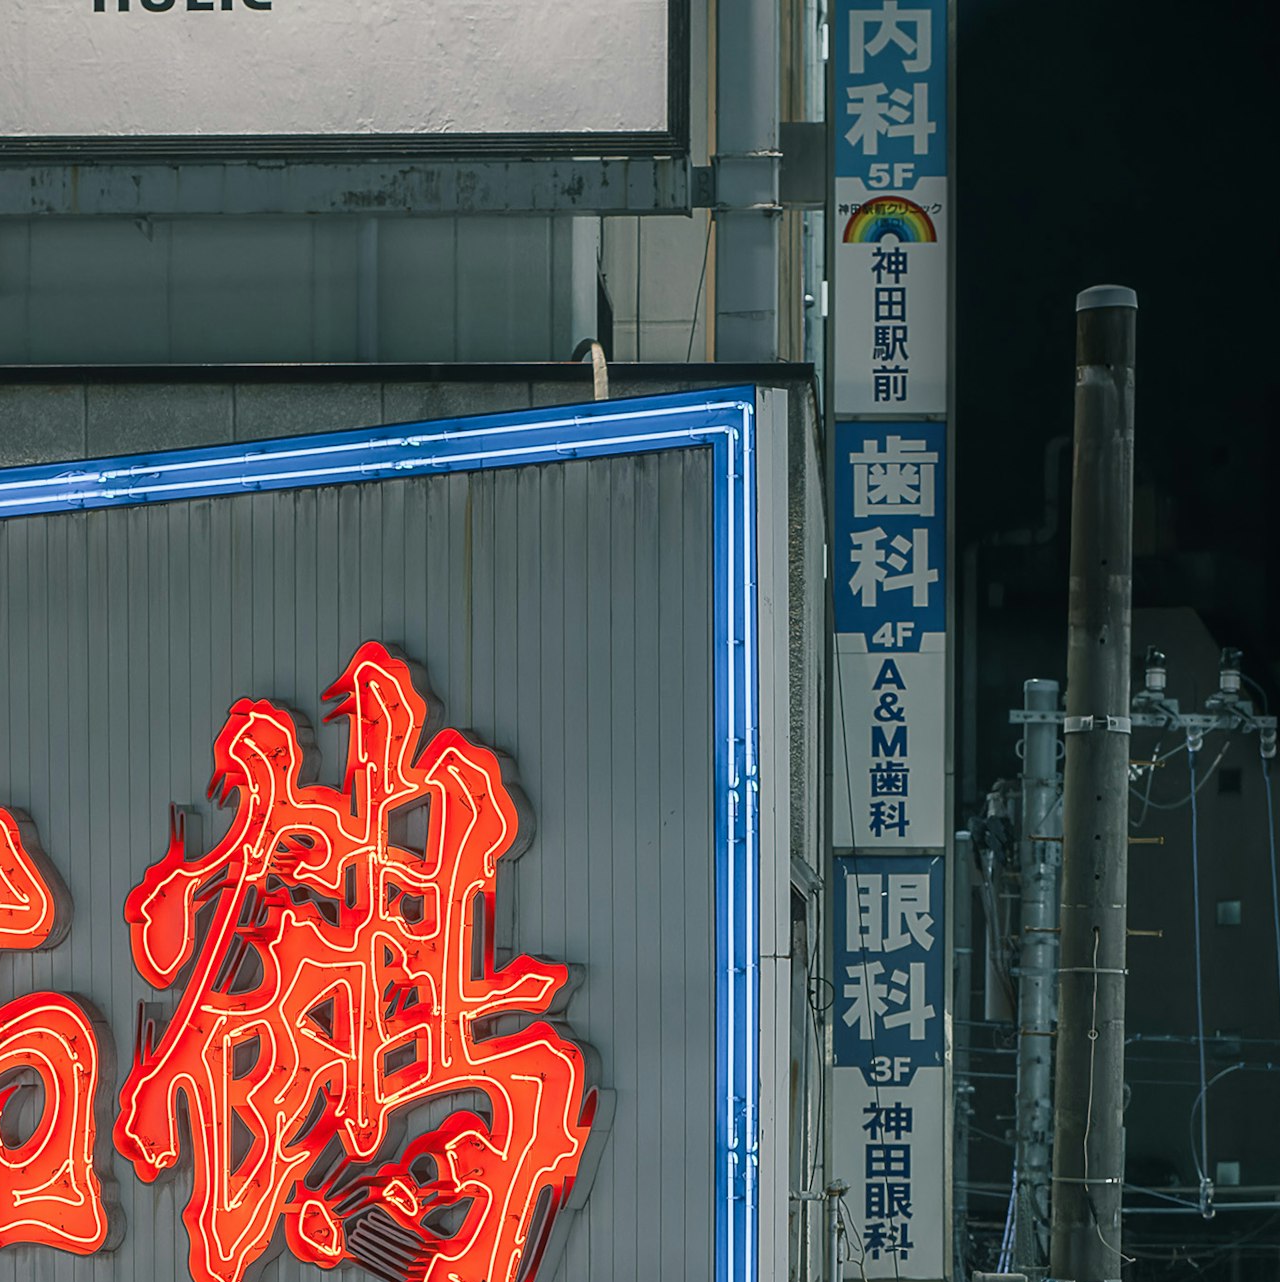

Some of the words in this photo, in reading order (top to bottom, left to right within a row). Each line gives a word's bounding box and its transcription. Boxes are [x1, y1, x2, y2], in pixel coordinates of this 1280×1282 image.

[845, 2, 936, 156] 内科
[868, 162, 915, 188] 5F
[871, 246, 909, 402] 神田駅前
[848, 435, 939, 608] 歯科
[872, 621, 915, 648] 4F
[869, 658, 910, 838] A&M歯科
[842, 873, 936, 1040] 眼科
[870, 1056, 911, 1082] 3F
[863, 1102, 914, 1260] 神田眼科
